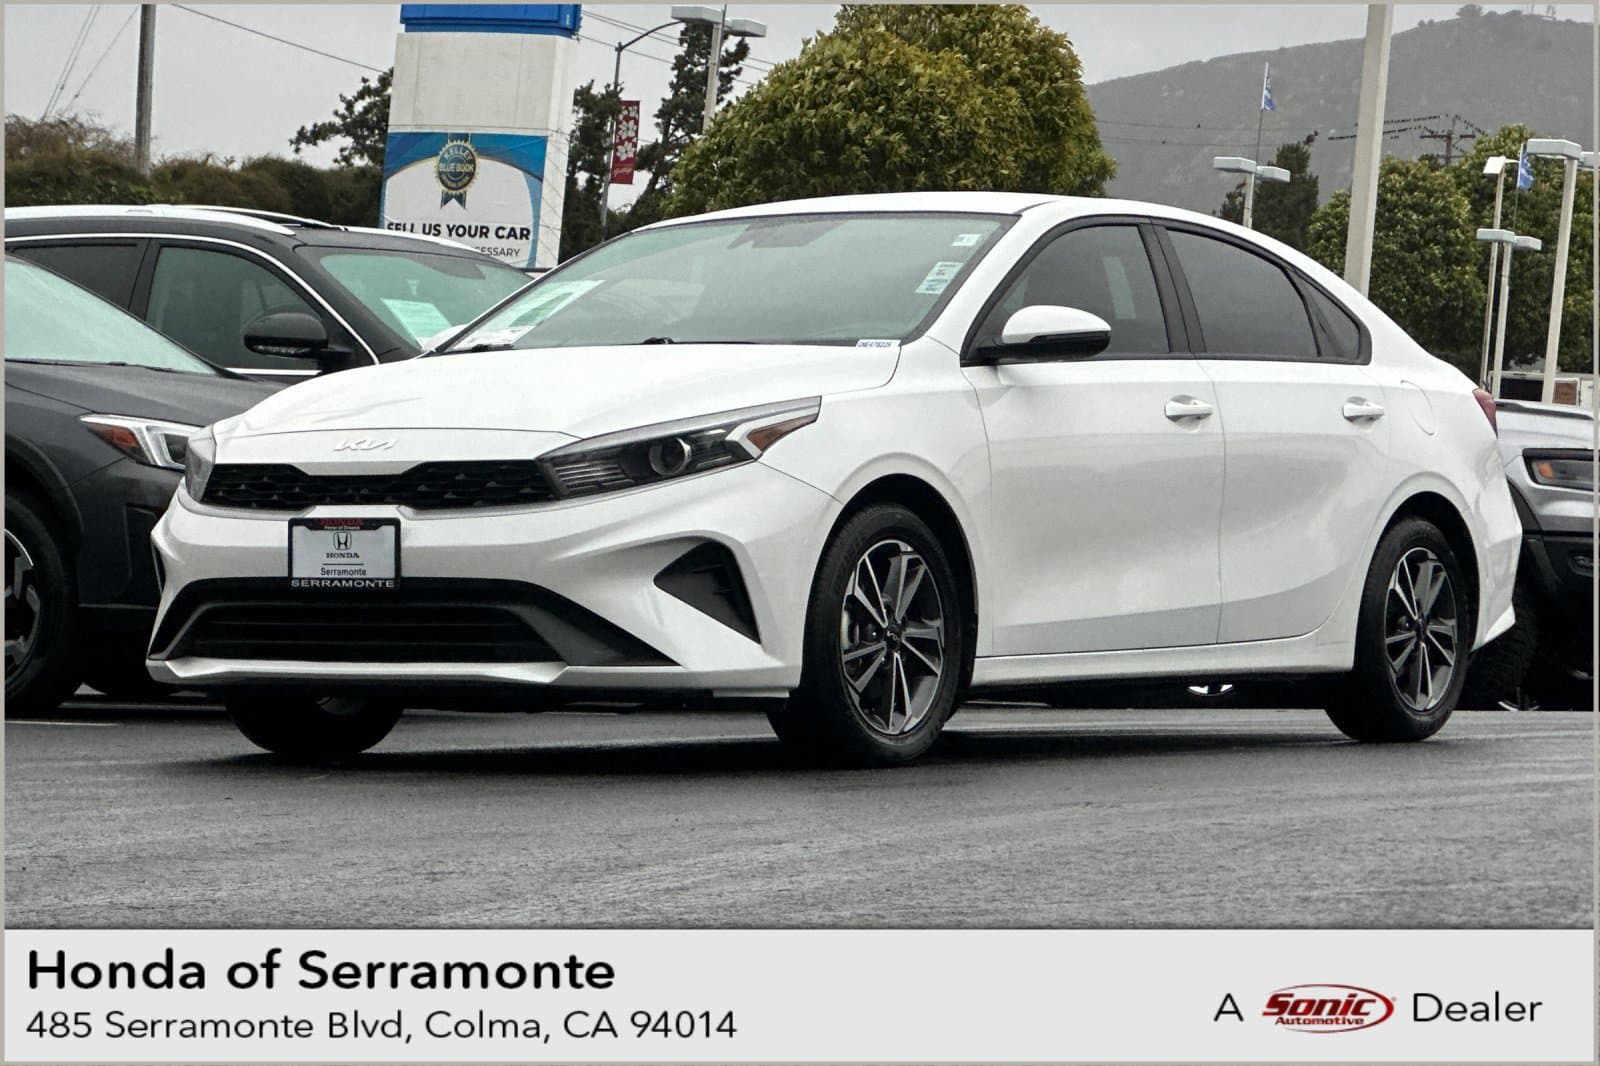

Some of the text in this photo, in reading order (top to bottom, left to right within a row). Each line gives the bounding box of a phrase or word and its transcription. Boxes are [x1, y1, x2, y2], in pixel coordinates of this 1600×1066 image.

[422, 223, 441, 236] US
[446, 224, 490, 239] YOUR
[495, 227, 531, 241] CAR
[320, 567, 367, 576] Serramonte
[291, 579, 395, 588] SERRAMONTE
